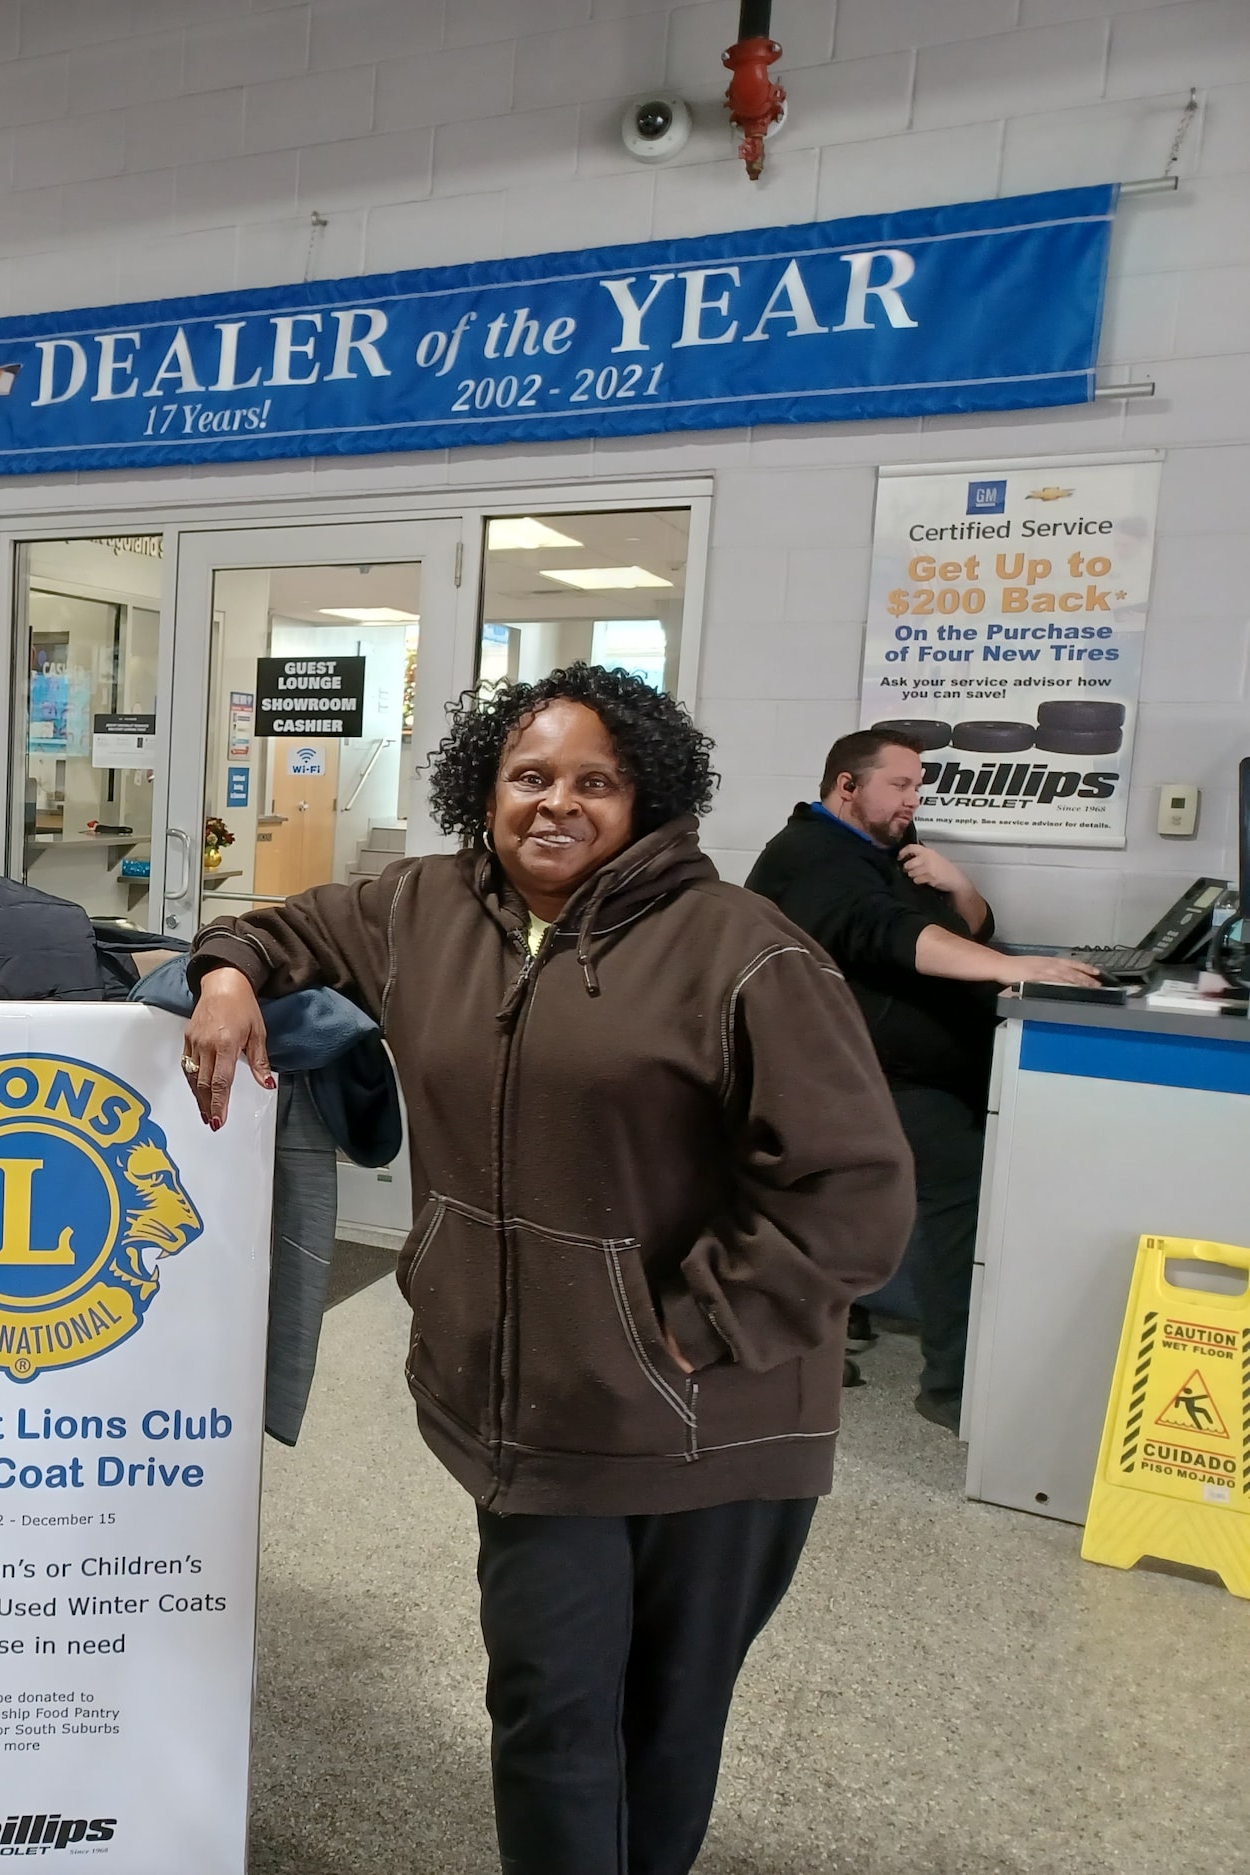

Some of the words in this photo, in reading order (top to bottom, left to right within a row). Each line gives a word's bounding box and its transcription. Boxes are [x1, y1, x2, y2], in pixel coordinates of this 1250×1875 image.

[31, 308, 392, 407] DEALER
[416, 311, 478, 377] of
[482, 307, 577, 359] the
[599, 248, 919, 354] YEAR
[451, 374, 544, 412] 2002
[569, 361, 665, 403] 2021
[143, 404, 176, 436] 17
[181, 399, 272, 434] Years!
[976, 488, 997, 503] GM
[909, 520, 1011, 542] Certified
[1021, 517, 1113, 538] Service
[908, 555, 980, 583] Get
[995, 552, 1052, 586] Up
[1068, 551, 1112, 577] to
[887, 587, 985, 618] $200
[895, 624, 928, 642] On
[937, 624, 977, 641] the
[986, 623, 1113, 641] Purchase
[885, 646, 909, 662] of
[918, 646, 974, 663] Four
[982, 646, 1040, 662] New
[1050, 645, 1119, 661] Tires
[284, 661, 337, 675] GUEST
[278, 676, 342, 690] LOUNGE
[880, 676, 908, 688] Ask
[913, 677, 946, 689] your
[950, 677, 1008, 688] service
[1013, 676, 1072, 688] advisor
[1077, 676, 1112, 687] how
[902, 690, 928, 700] you
[933, 690, 961, 699] can
[966, 688, 1006, 699] save!
[261, 697, 357, 712] SHOWROOM
[273, 718, 343, 733] CASHIER
[921, 762, 1120, 804] Phillips
[919, 796, 1033, 809] EVROLET
[1056, 804, 1081, 813] Since
[1084, 804, 1106, 813] 1968
[939, 817, 953, 825] may
[956, 818, 979, 827] apply.
[999, 819, 1029, 827] service
[1032, 820, 1062, 828] advisor
[1065, 820, 1077, 828] for
[1079, 821, 1111, 829] details.
[1163, 1323, 1237, 1347] CAUTION
[1161, 1340, 1187, 1352] WET
[1193, 1346, 1235, 1360] FLOOR
[18, 1408, 127, 1440] Lions
[141, 1407, 232, 1440] Club
[1143, 1443, 1237, 1474] CUIDADO
[98, 1456, 205, 1488] Drive
[1141, 1462, 1173, 1477] PISO
[1177, 1469, 1236, 1489] MOJADO
[21, 1513, 94, 1526] December
[99, 1513, 116, 1525] 15
[46, 1564, 72, 1578] or
[81, 1555, 202, 1576] Children's
[69, 1595, 149, 1615] Winter
[158, 1594, 226, 1613] Coats
[35, 1636, 56, 1654] in
[67, 1634, 126, 1654] need
[18, 1691, 75, 1703] donated
[80, 1692, 94, 1703] to
[36, 1707, 69, 1719] Food
[74, 1707, 120, 1720] Pantry
[15, 1724, 56, 1735] South
[61, 1723, 120, 1735] Suburbs
[4, 1742, 40, 1751] more
